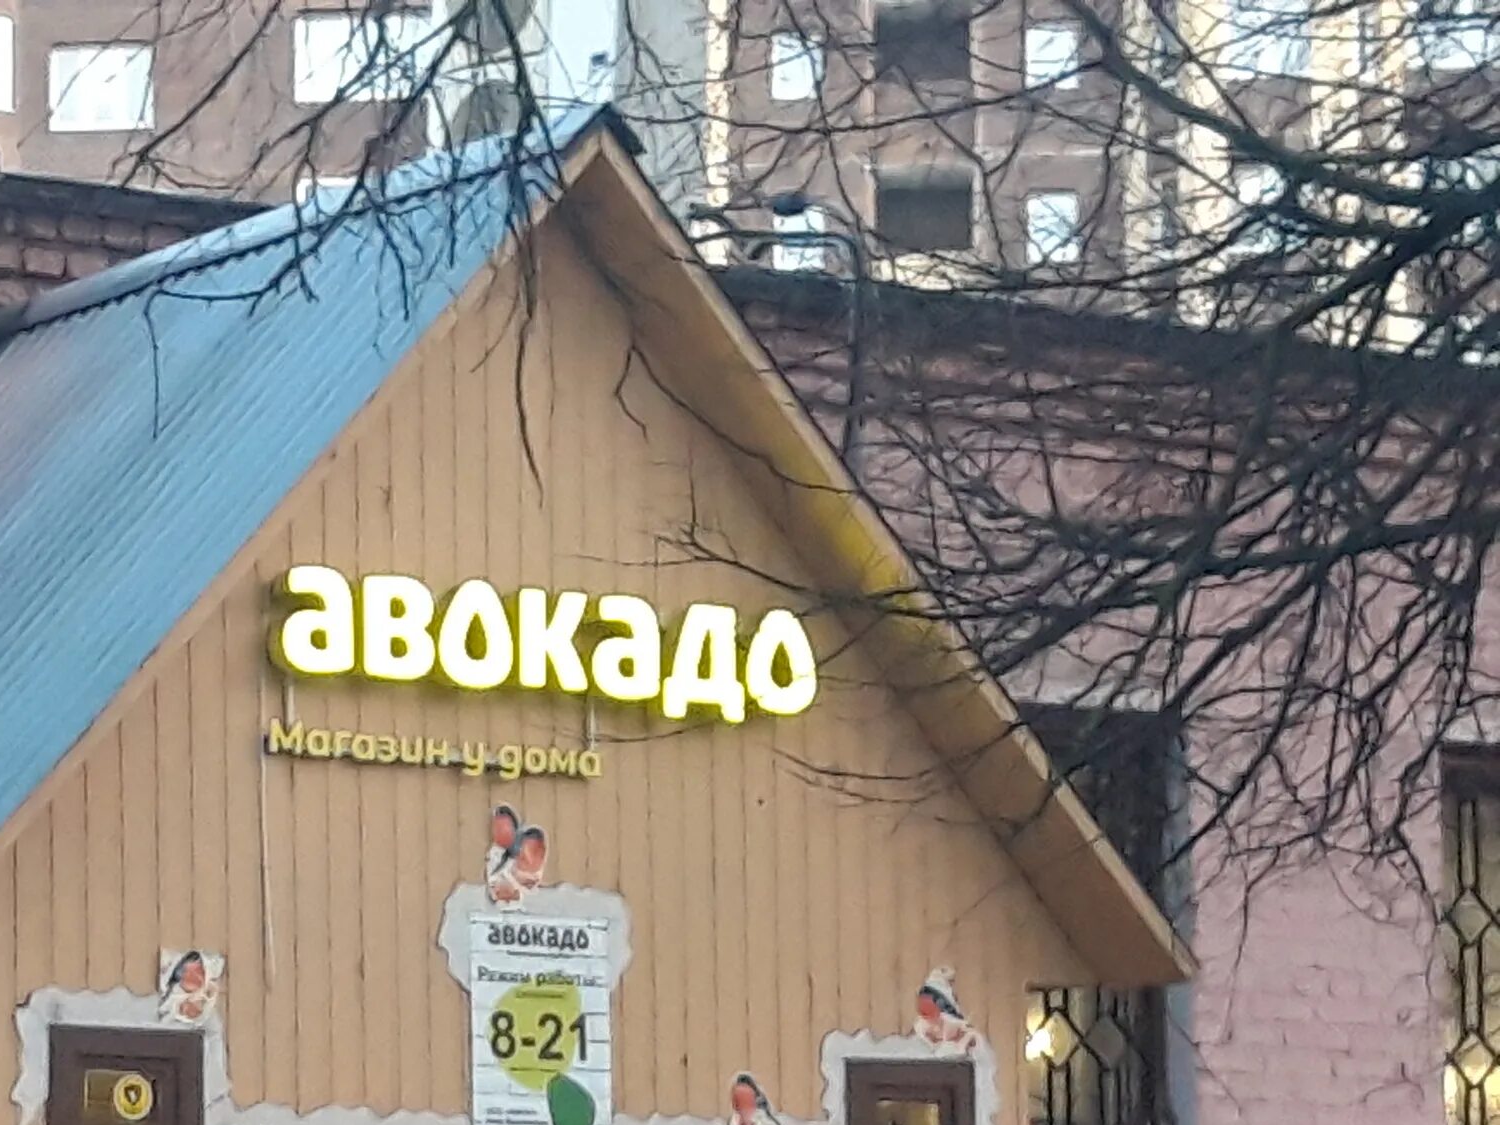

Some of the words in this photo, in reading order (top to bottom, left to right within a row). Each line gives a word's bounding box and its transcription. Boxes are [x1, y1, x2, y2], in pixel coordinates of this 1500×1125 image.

[281, 564, 818, 723] авокадо
[269, 717, 449, 765] Магазин
[463, 740, 485, 777] у
[499, 743, 601, 780] дома
[488, 923, 590, 950] авокадо
[490, 1009, 588, 1062] 8-21
